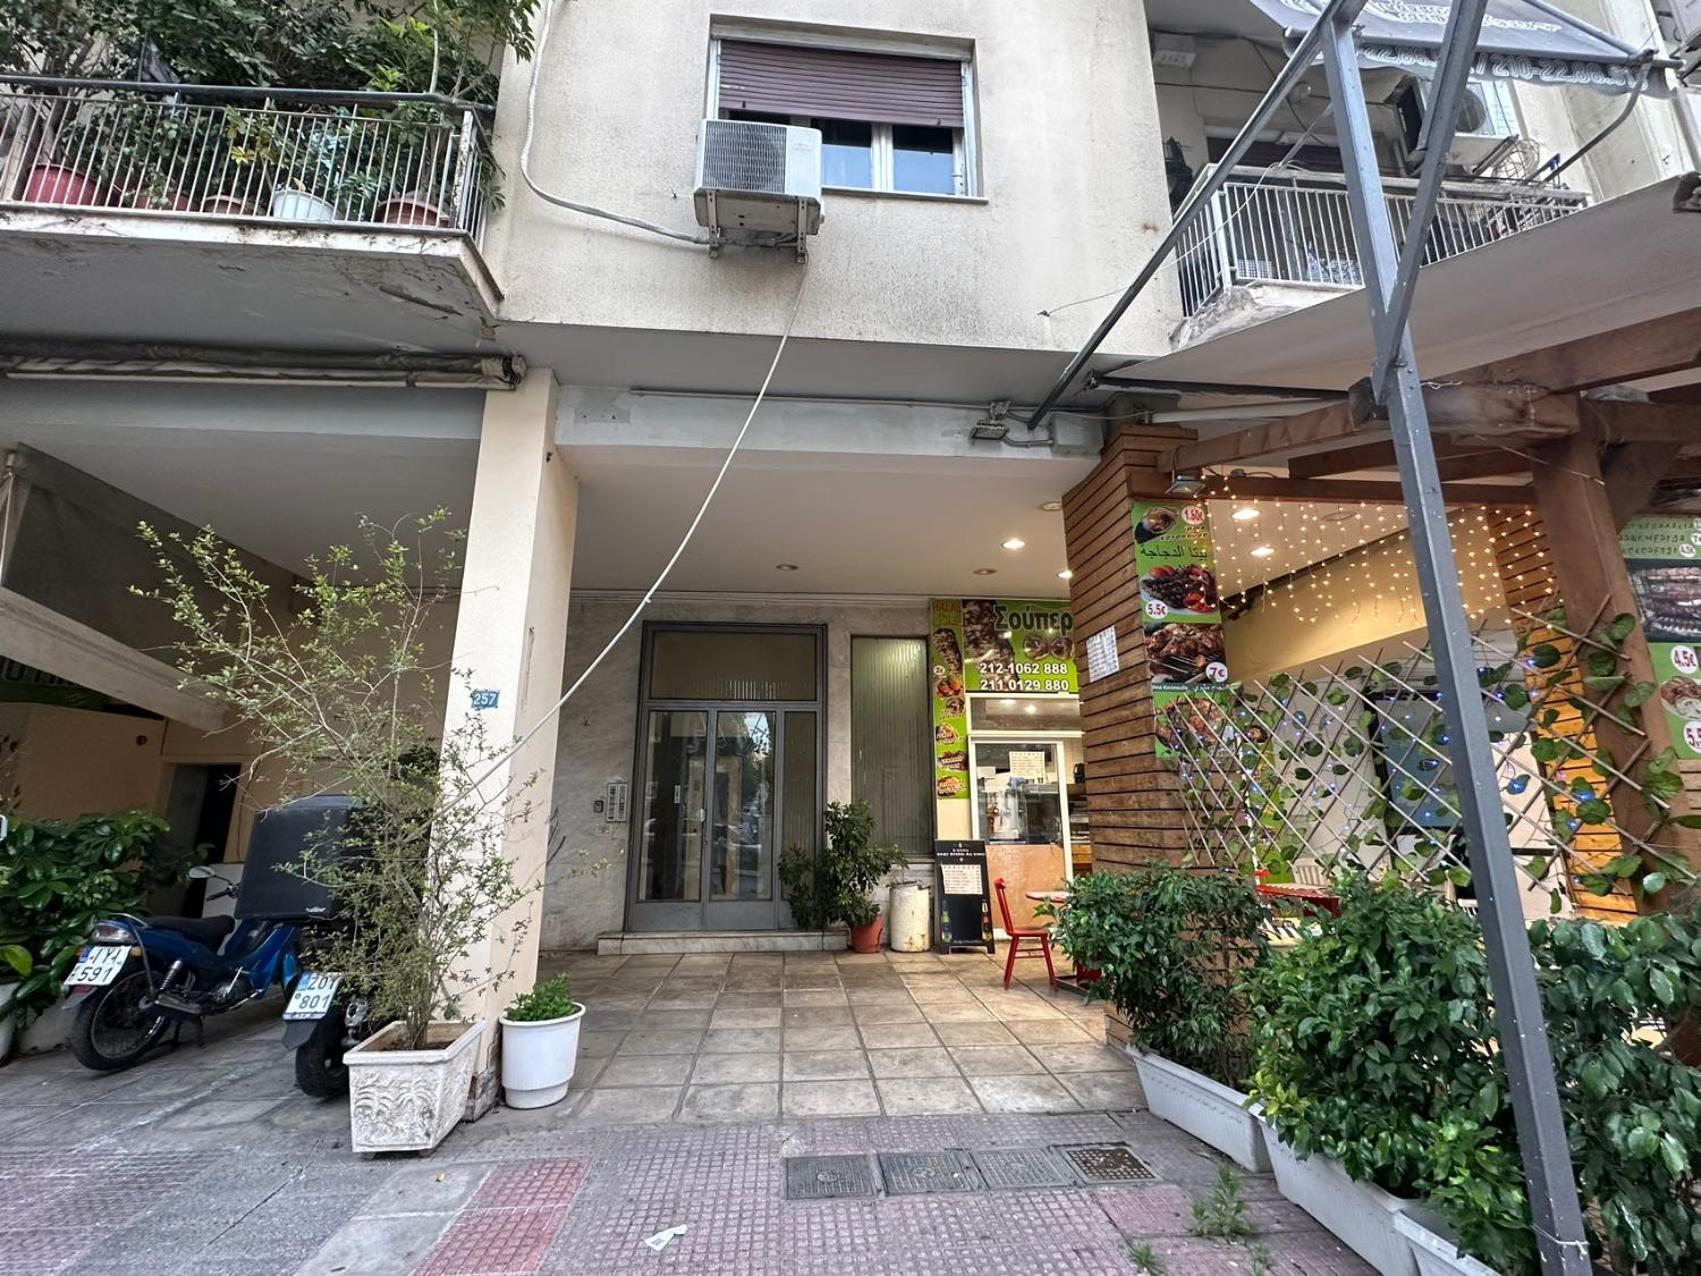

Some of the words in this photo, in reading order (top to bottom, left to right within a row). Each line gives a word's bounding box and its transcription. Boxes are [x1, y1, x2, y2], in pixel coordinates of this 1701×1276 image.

[993, 604, 1073, 636] Σούπερ
[1044, 662, 1068, 674] 888
[980, 679, 1004, 691] 211
[1045, 679, 1069, 691] 880
[473, 692, 497, 705] 257
[77, 966, 113, 982] 591
[299, 994, 331, 1009] 801
